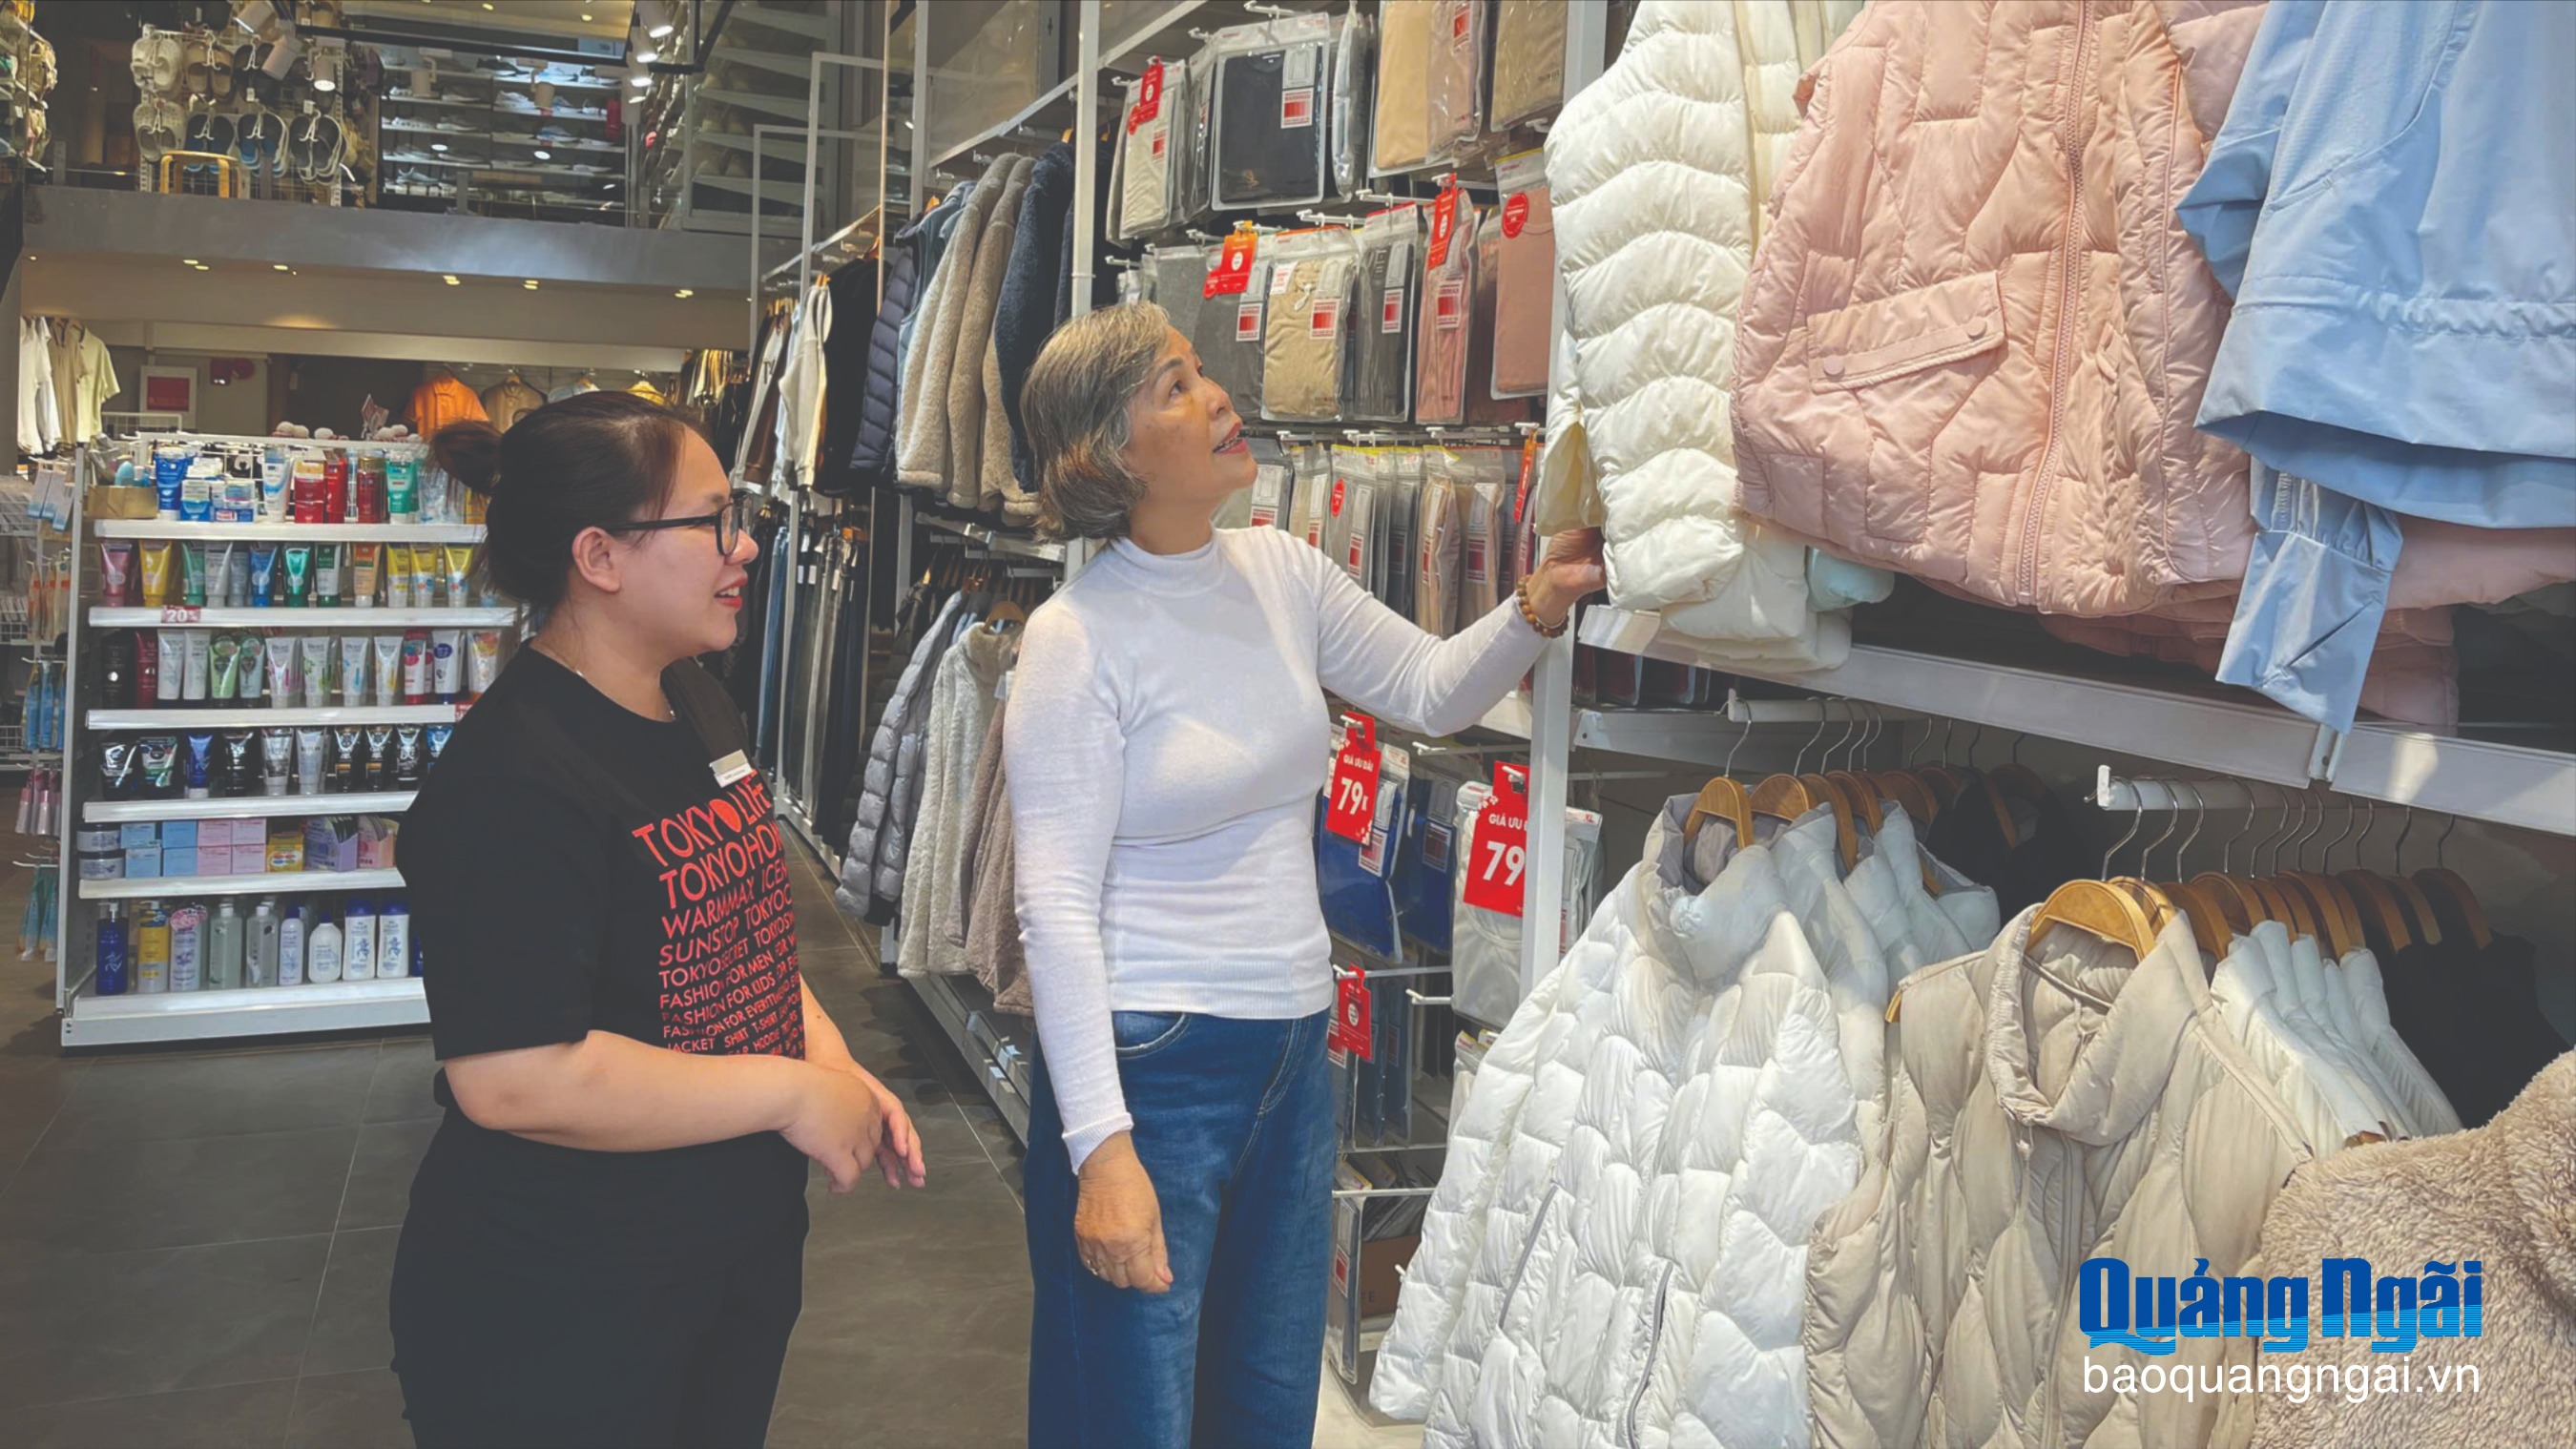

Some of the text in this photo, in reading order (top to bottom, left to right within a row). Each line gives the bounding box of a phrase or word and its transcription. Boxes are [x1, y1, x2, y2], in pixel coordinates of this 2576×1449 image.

[1488, 813, 1506, 827] GIÁ
[1584, 813, 1595, 823] XL
[1483, 840, 1526, 886] 79
[658, 916, 739, 967] SUNSTOP
[659, 980, 724, 1009] FASHION
[726, 963, 748, 986] FOR
[747, 950, 775, 976] MEN
[726, 985, 754, 1009] FOR
[722, 1009, 747, 1029] FOR
